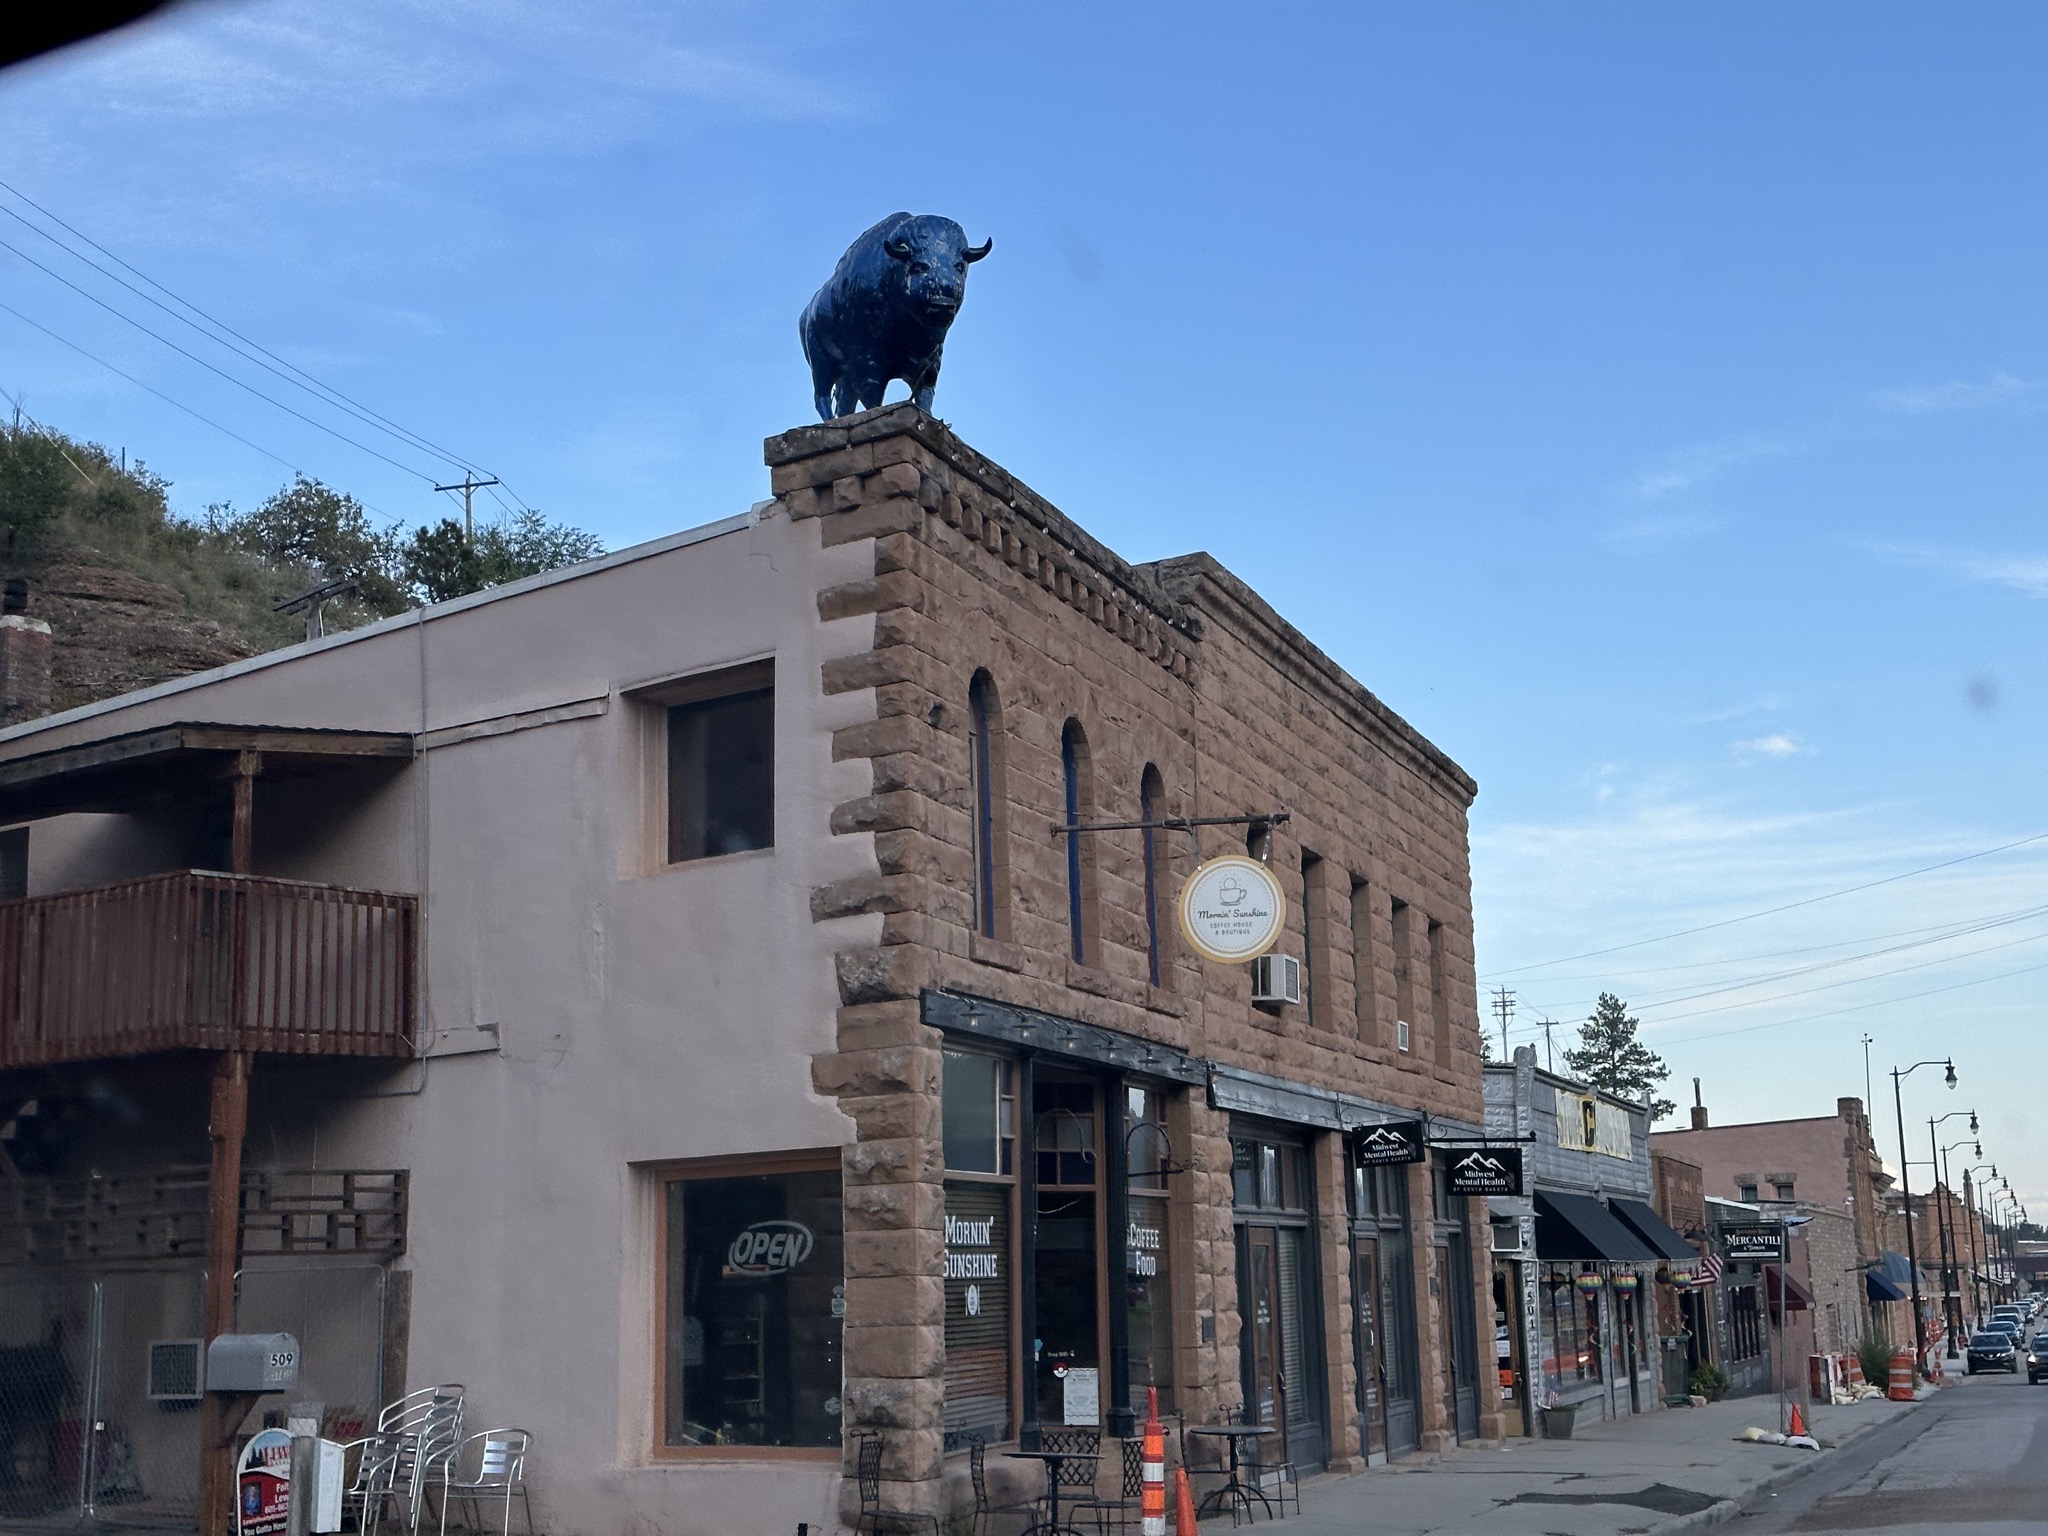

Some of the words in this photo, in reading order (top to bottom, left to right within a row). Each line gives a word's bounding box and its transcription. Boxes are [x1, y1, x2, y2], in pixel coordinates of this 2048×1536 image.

[1233, 908, 1268, 919] Sunshine
[1210, 921, 1231, 929] COFFEE
[1387, 1149, 1409, 1157] Health
[1464, 1170, 1495, 1178] Midwest
[1455, 1178, 1480, 1186] Mental
[1481, 1178, 1506, 1186] Health
[1130, 1223, 1160, 1248] COFFEE
[733, 1231, 804, 1268] OPEN
[1136, 1251, 1156, 1276] FOOD
[271, 1353, 293, 1366] 509
